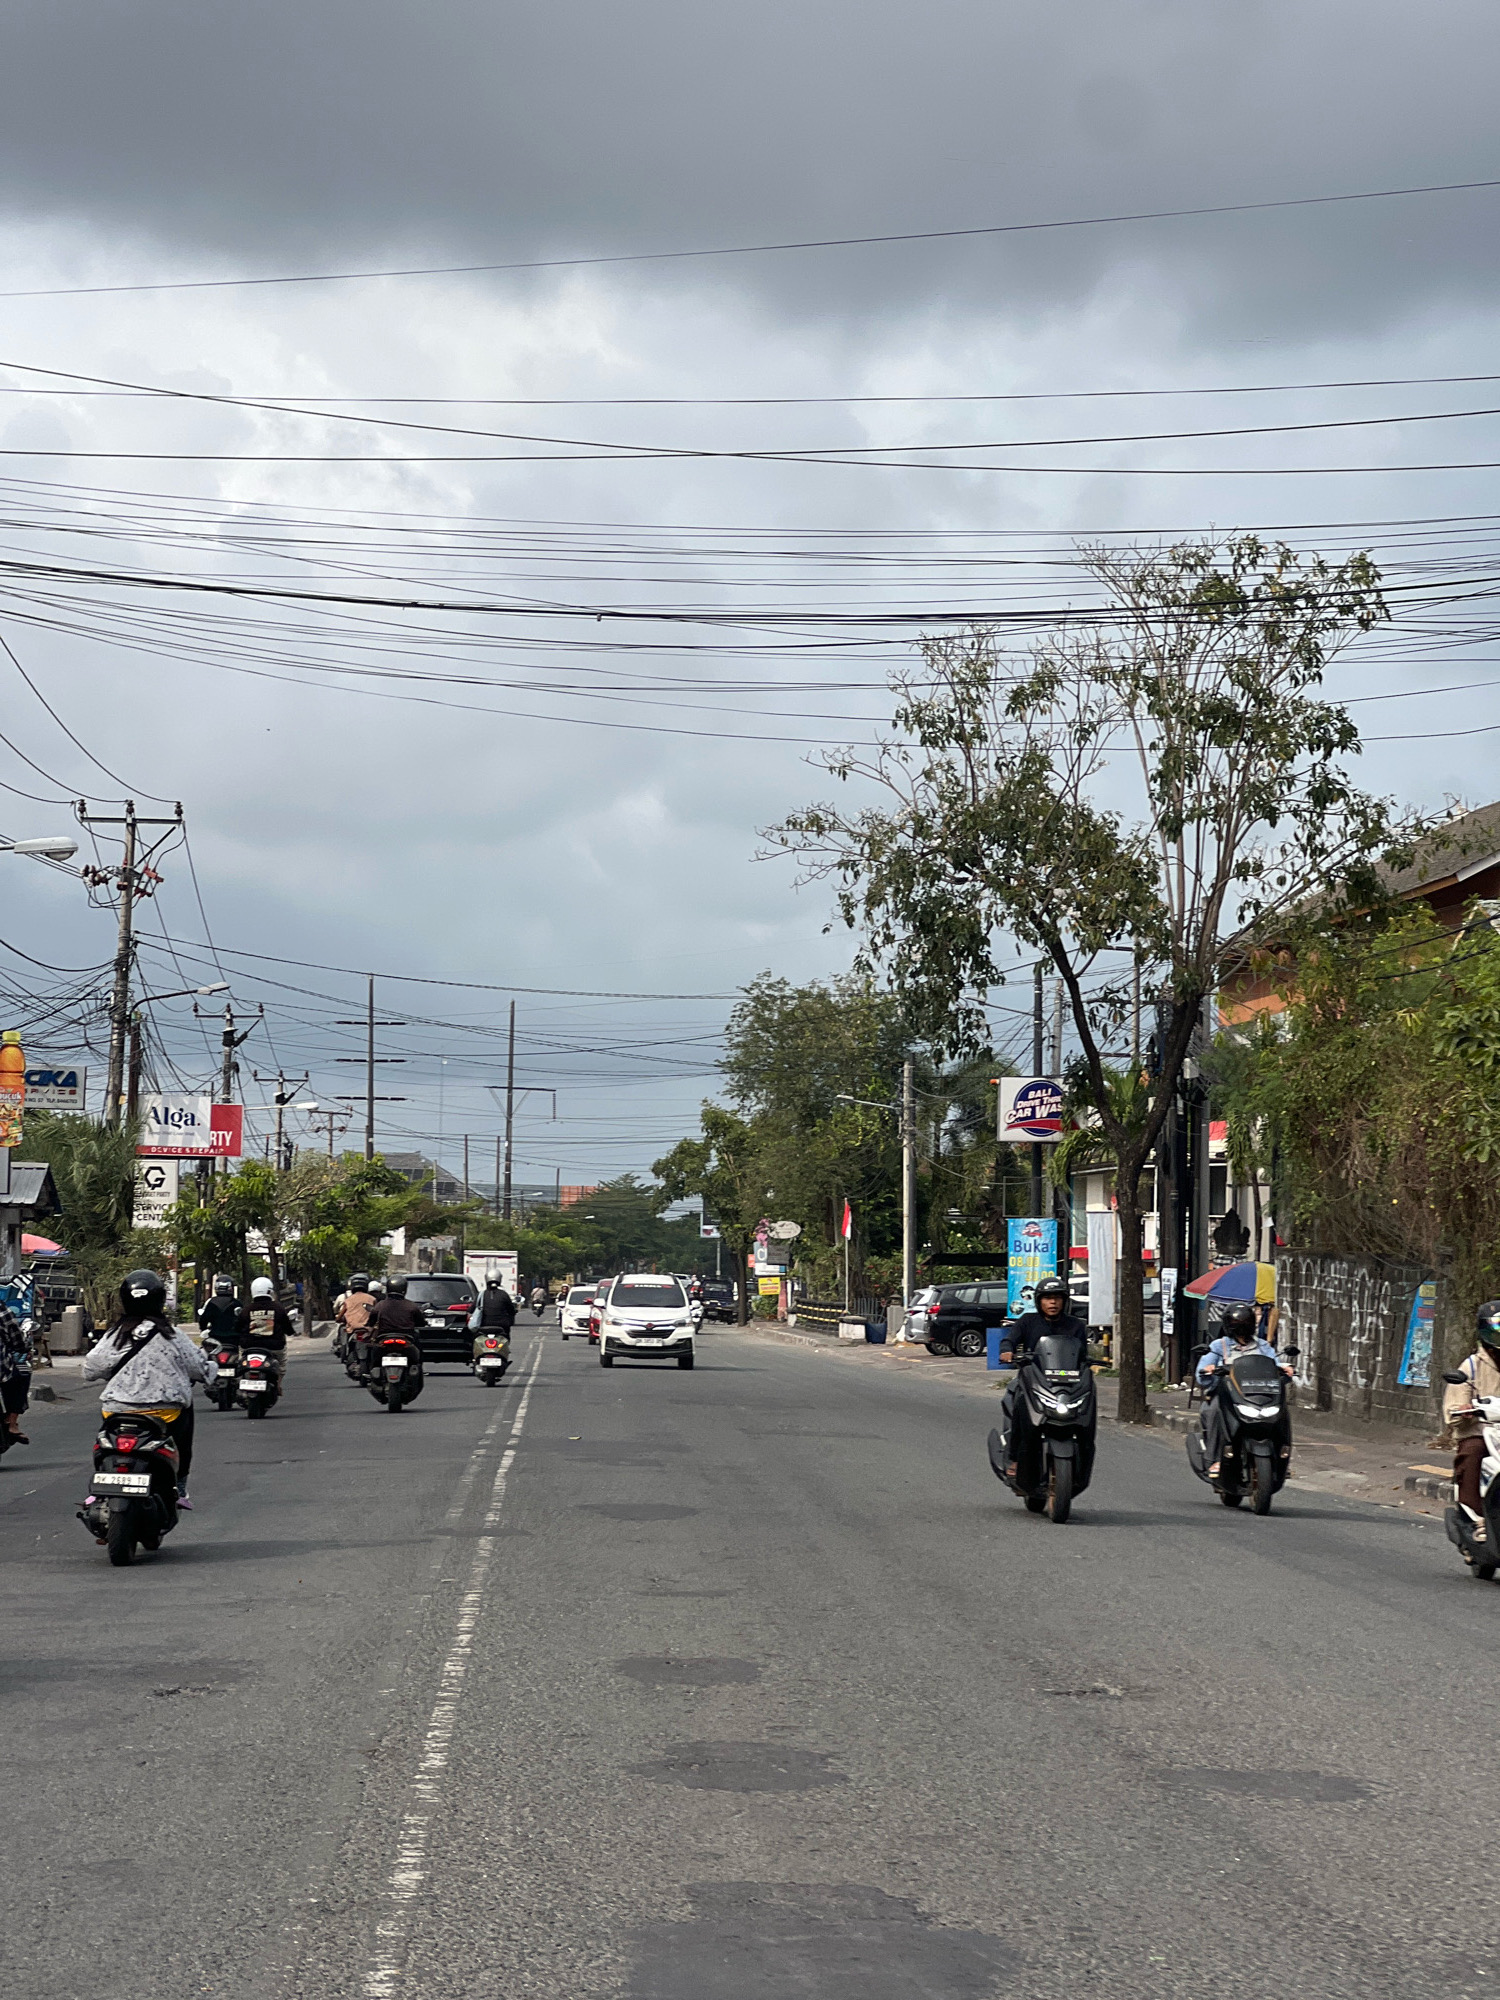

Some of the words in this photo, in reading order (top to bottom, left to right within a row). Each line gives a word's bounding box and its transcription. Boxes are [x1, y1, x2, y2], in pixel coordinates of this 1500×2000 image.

[1028, 1088, 1052, 1099] BALI
[1016, 1099, 1041, 1109] DRIVE
[1005, 1107, 1032, 1124] CAR
[1035, 1103, 1064, 1119] WAS
[210, 1131, 233, 1147] RTY
[134, 1203, 168, 1211] SERVIC
[136, 1213, 163, 1221] CENT
[1014, 1239, 1049, 1253] Buka
